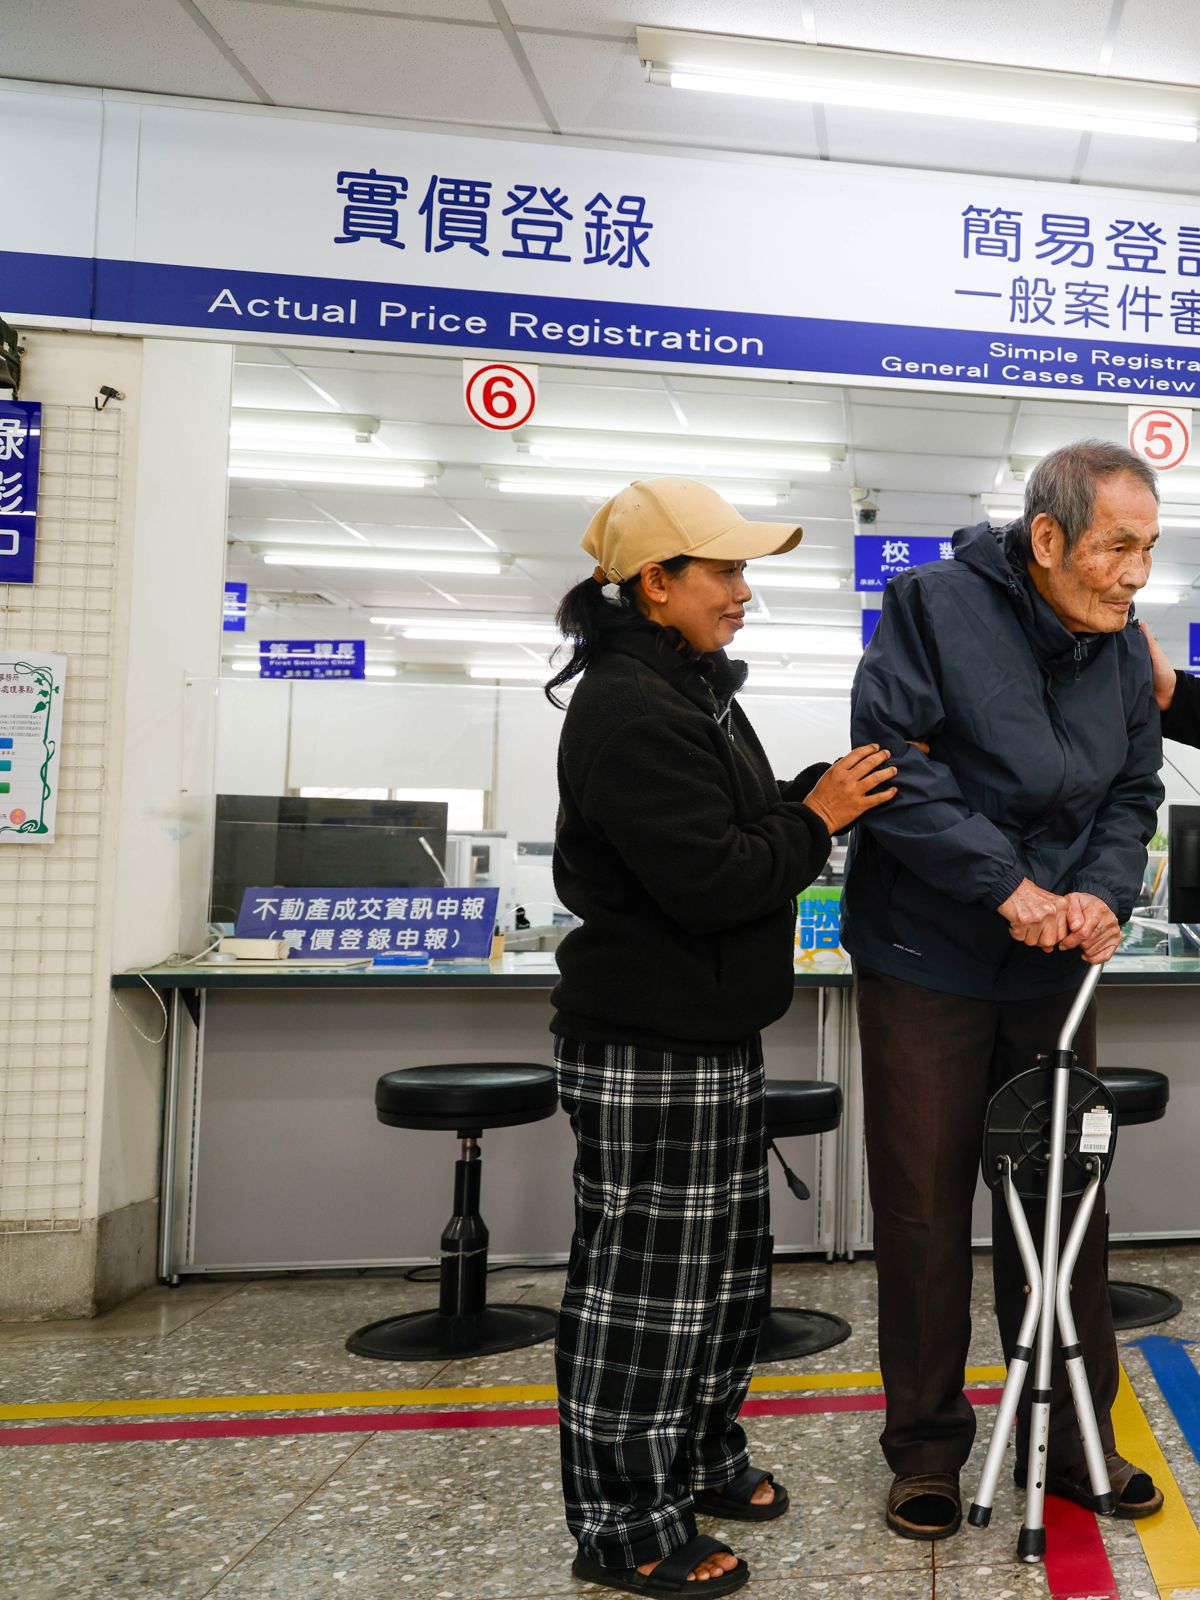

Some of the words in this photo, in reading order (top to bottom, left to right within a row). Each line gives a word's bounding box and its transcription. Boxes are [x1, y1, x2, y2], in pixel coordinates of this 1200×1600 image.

[333, 168, 654, 269] 實價登錄
[207, 288, 357, 325] Actual
[379, 301, 488, 335] Price
[508, 311, 765, 356] Registration
[881, 355, 989, 379] General
[1001, 364, 1084, 386] Cases
[1097, 371, 1196, 393] Review
[988, 341, 1078, 367] Simple
[482, 375, 517, 419] 6
[1143, 420, 1173, 460] 5
[252, 896, 487, 922] 不動產成交資訊申報
